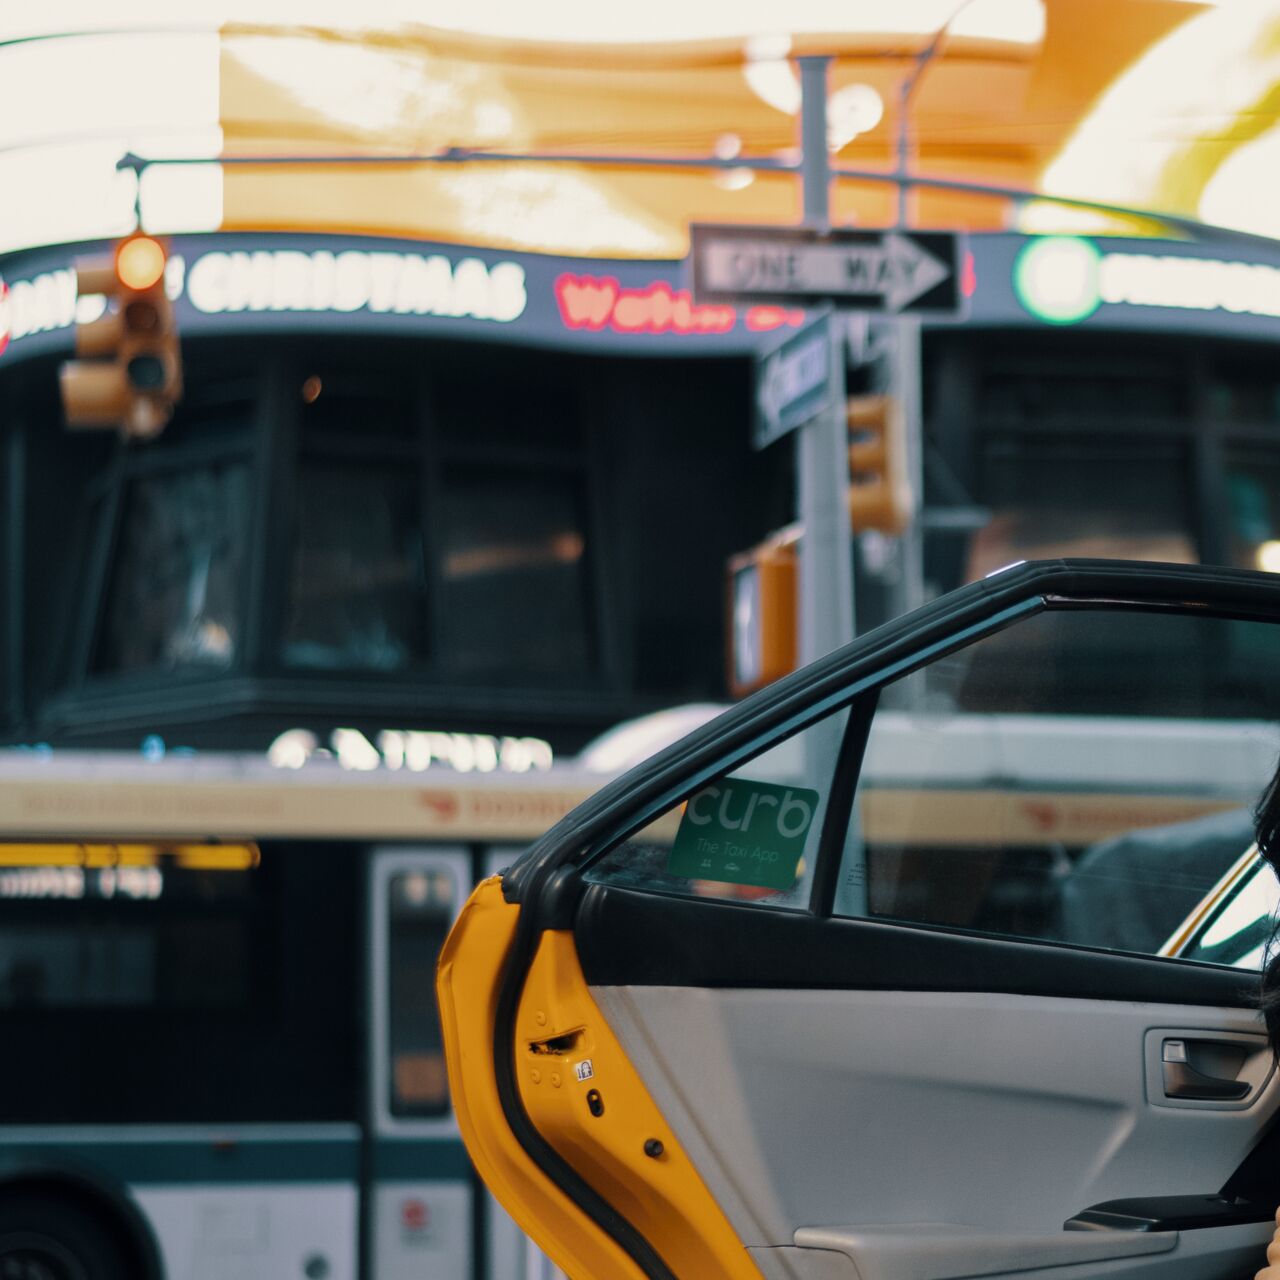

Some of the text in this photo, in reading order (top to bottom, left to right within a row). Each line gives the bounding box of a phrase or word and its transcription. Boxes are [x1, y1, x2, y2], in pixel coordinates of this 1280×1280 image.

[732, 252, 918, 287] ONE WAY
[687, 785, 812, 839] curb
[697, 838, 779, 863] The Taxi App
